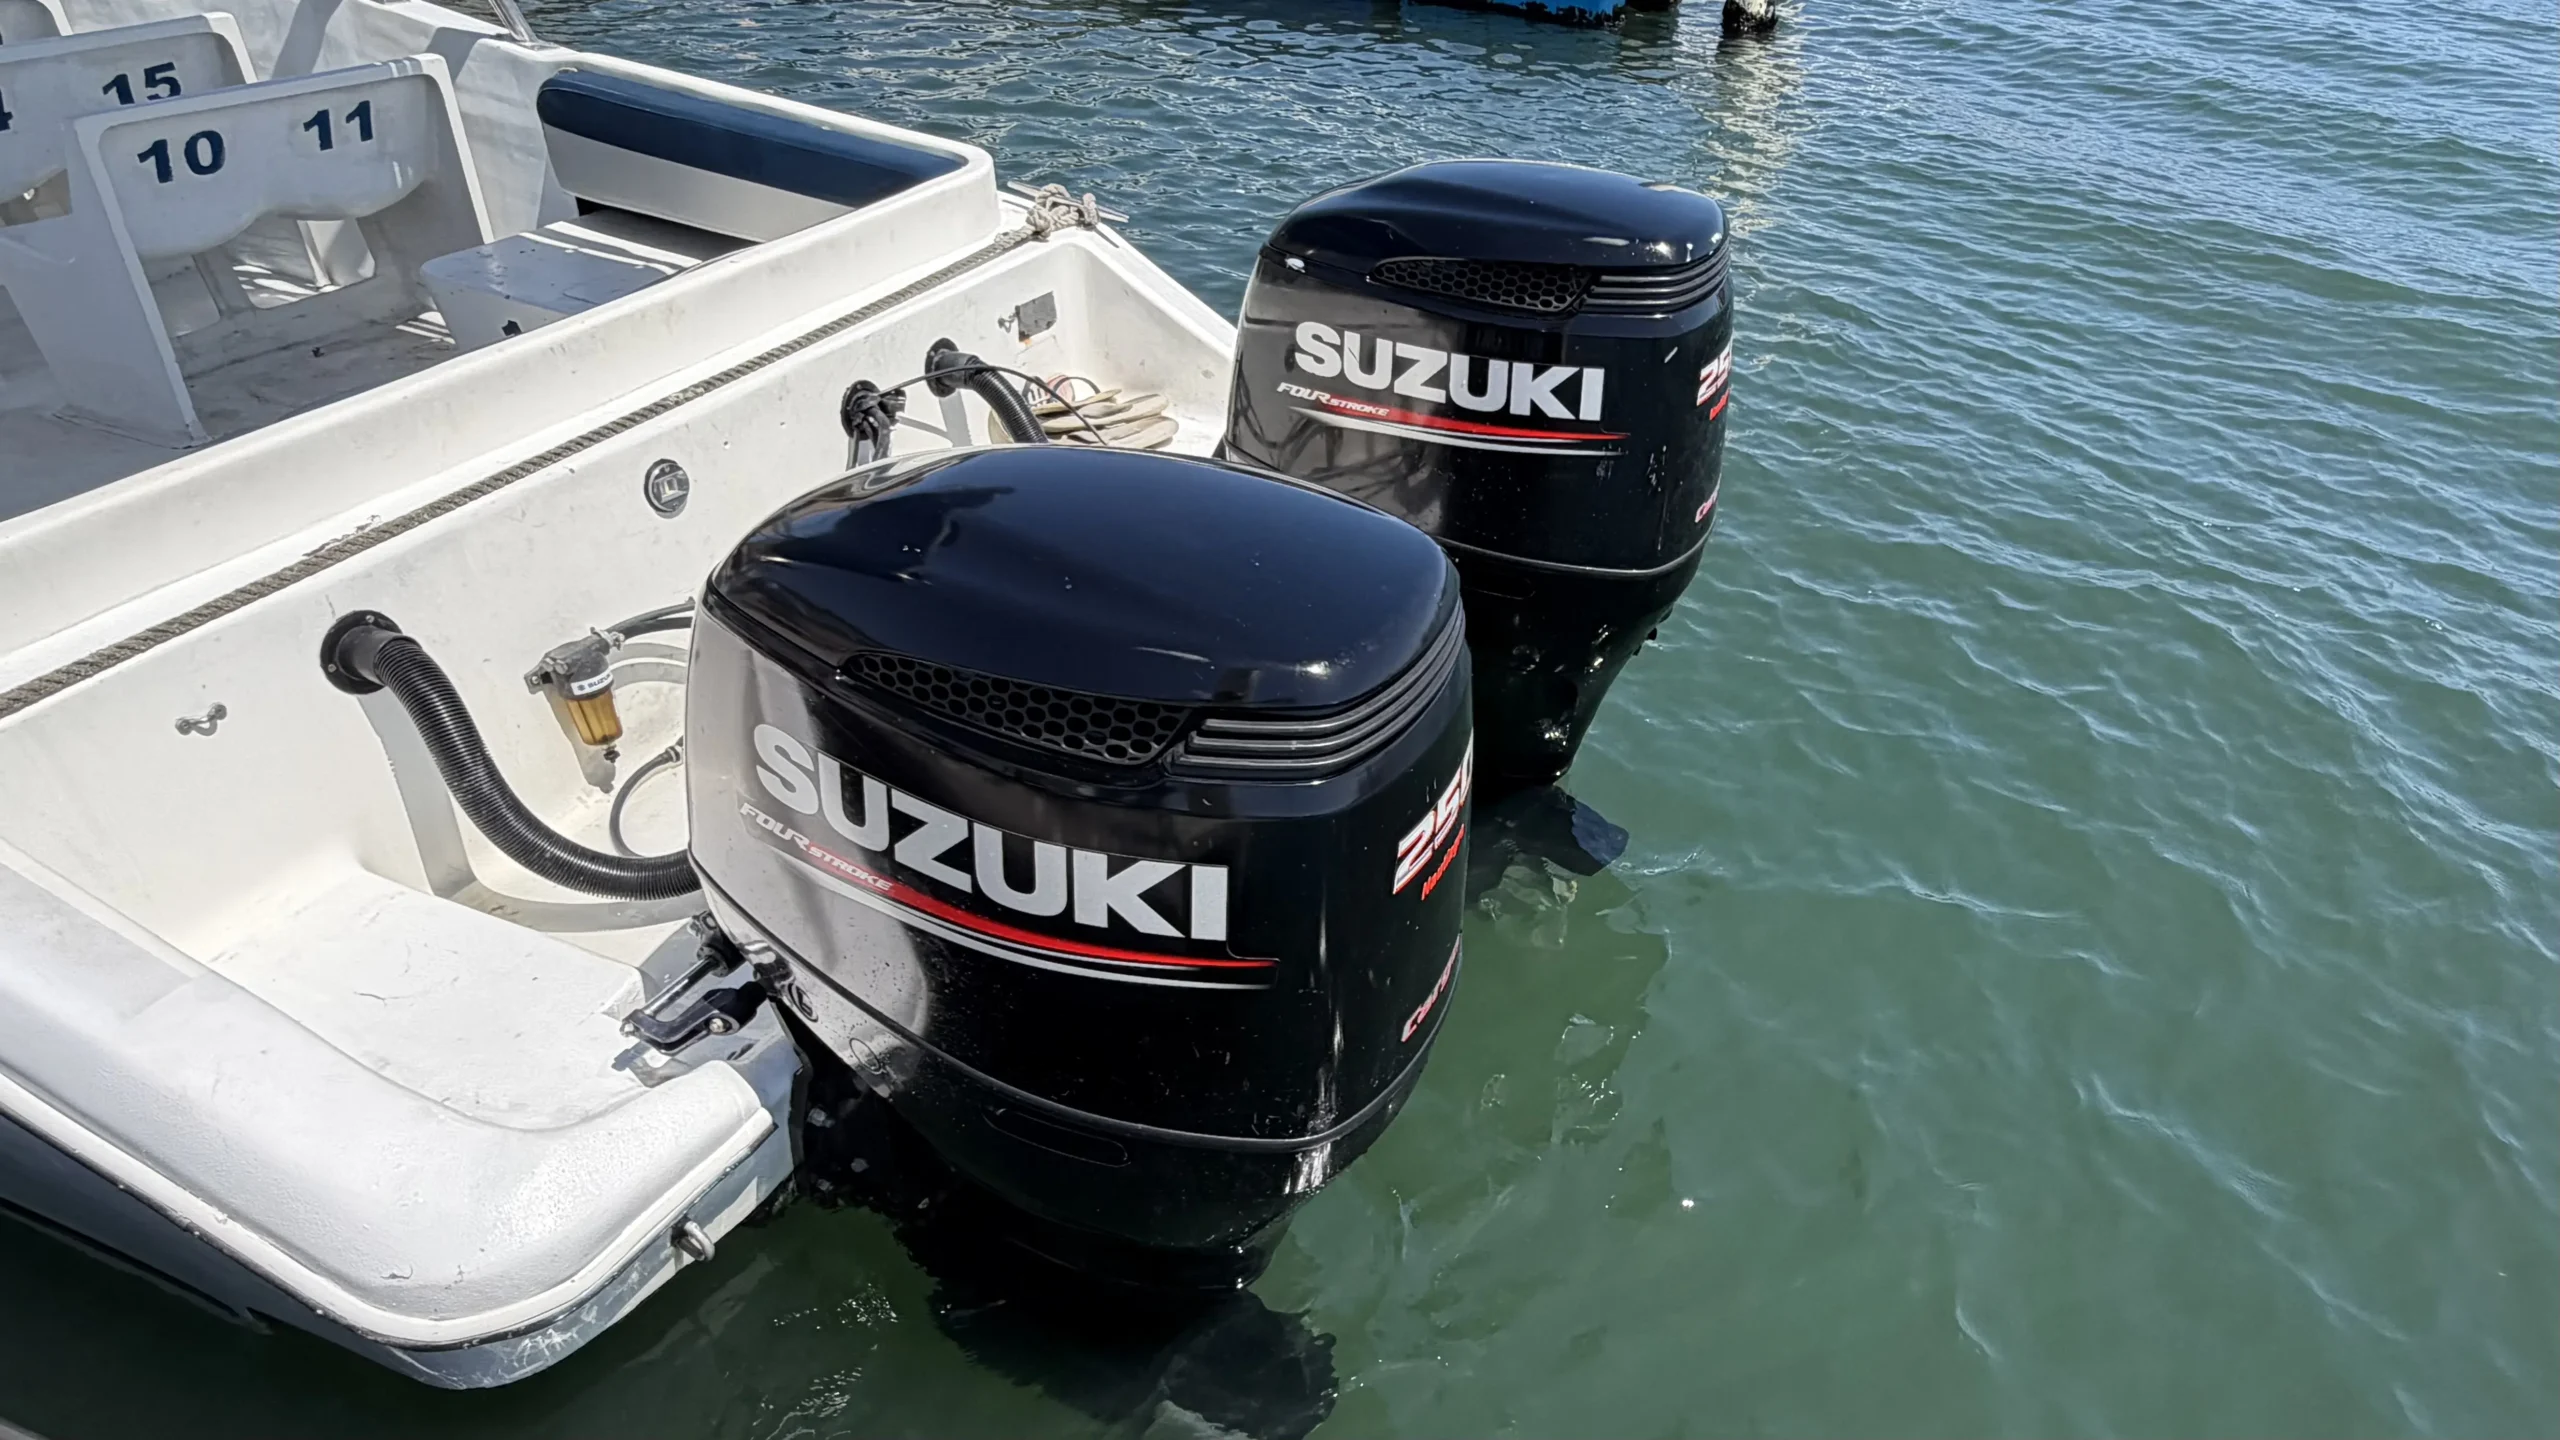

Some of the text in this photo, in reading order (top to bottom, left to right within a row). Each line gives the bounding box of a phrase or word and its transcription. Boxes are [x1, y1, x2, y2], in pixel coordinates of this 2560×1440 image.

[102, 62, 181, 105] 15
[136, 129, 226, 184] 10
[303, 100, 373, 151] 11
[1277, 382, 1389, 417] FOUR STROKE
[1294, 321, 1605, 422] SUZUKI
[1696, 328, 1735, 406] 25
[739, 802, 893, 890] FOUR STROKE
[753, 723, 1229, 942] SUZUKI
